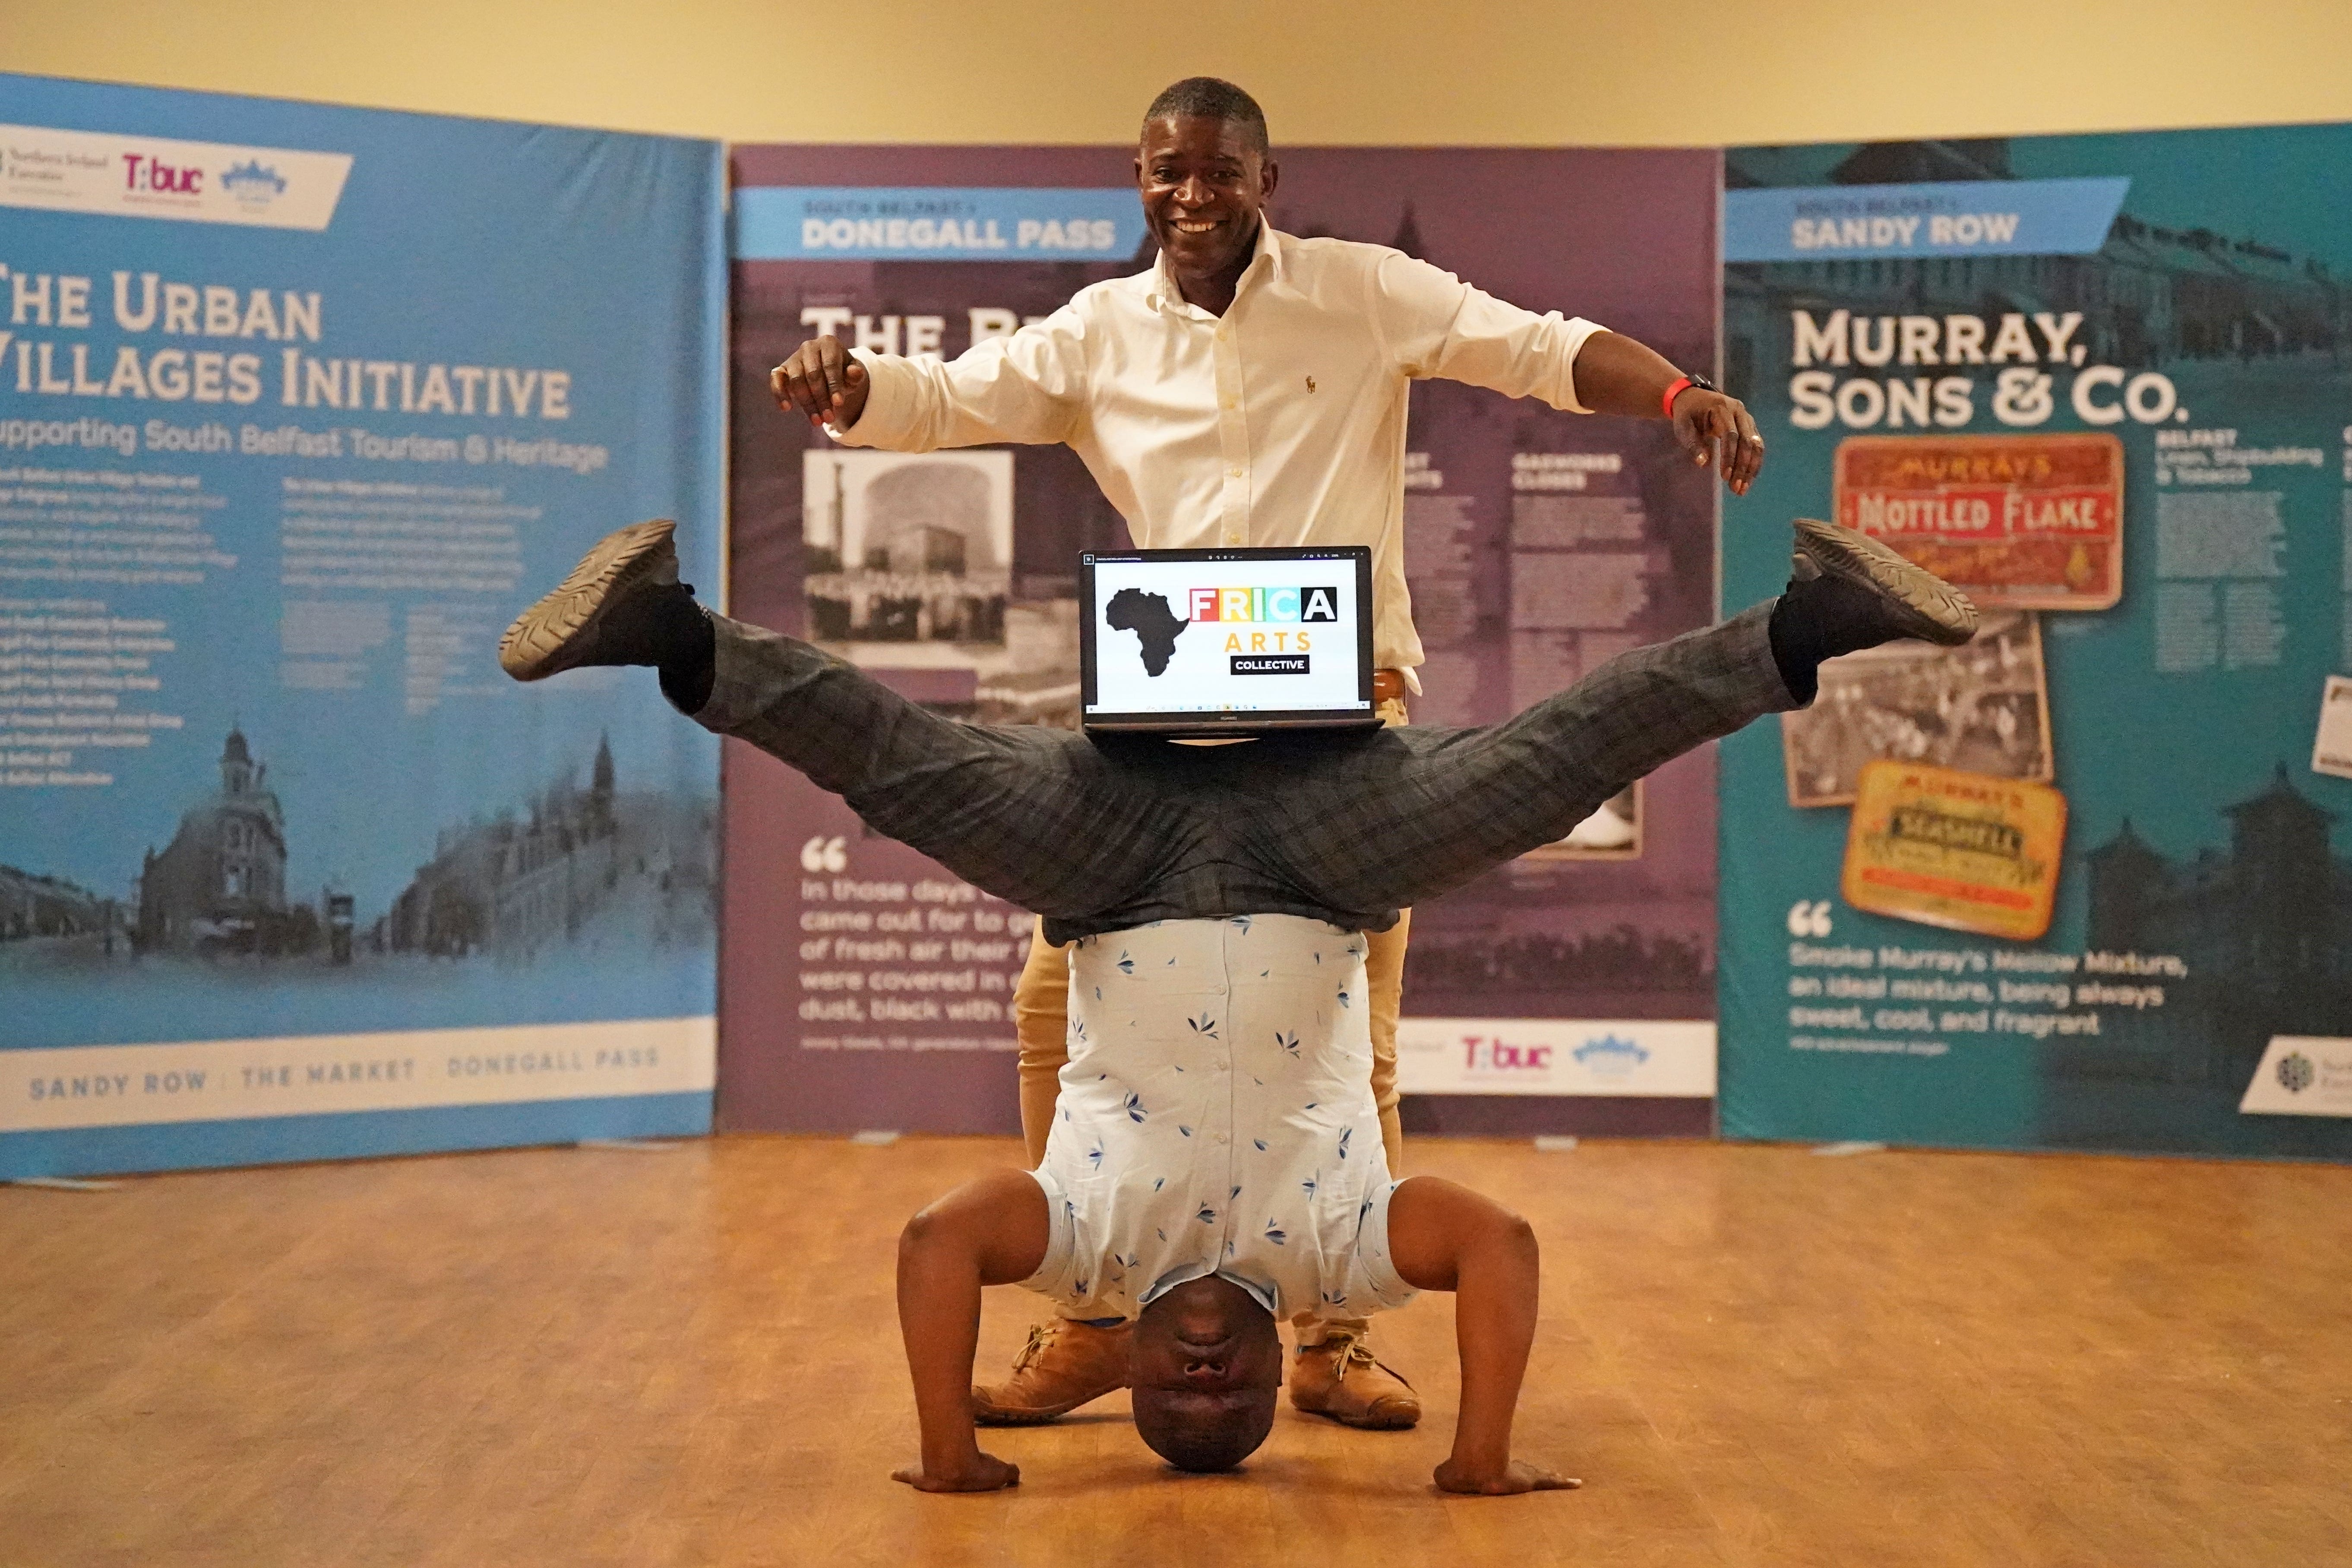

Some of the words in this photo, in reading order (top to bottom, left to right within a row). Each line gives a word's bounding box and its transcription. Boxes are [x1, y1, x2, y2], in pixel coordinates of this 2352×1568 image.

[801, 219, 1007, 250] DONEGALL
[1017, 219, 1115, 250] PASS
[1792, 216, 1920, 250] SANDY
[1929, 212, 2019, 245] ROW
[0, 262, 92, 329] HE
[282, 348, 571, 419] INITIATIVE
[1789, 370, 1974, 430] SONS
[1992, 366, 2054, 426] &
[145, 419, 232, 452] South
[1225, 632, 1311, 652] ARTS
[1236, 660, 1305, 670] COLLECTIVE
[877, 908, 922, 932] out
[928, 908, 967, 932] for
[974, 909, 1005, 932] to
[800, 937, 831, 961] of
[870, 997, 941, 1022] black
[29, 1074, 129, 1102] SANDY
[143, 1069, 206, 1094] ROW
[242, 1065, 291, 1091] THE
[306, 1058, 415, 1085] MARKET
[447, 1051, 582, 1078] DONEGALL
[595, 1047, 659, 1070] PASS
